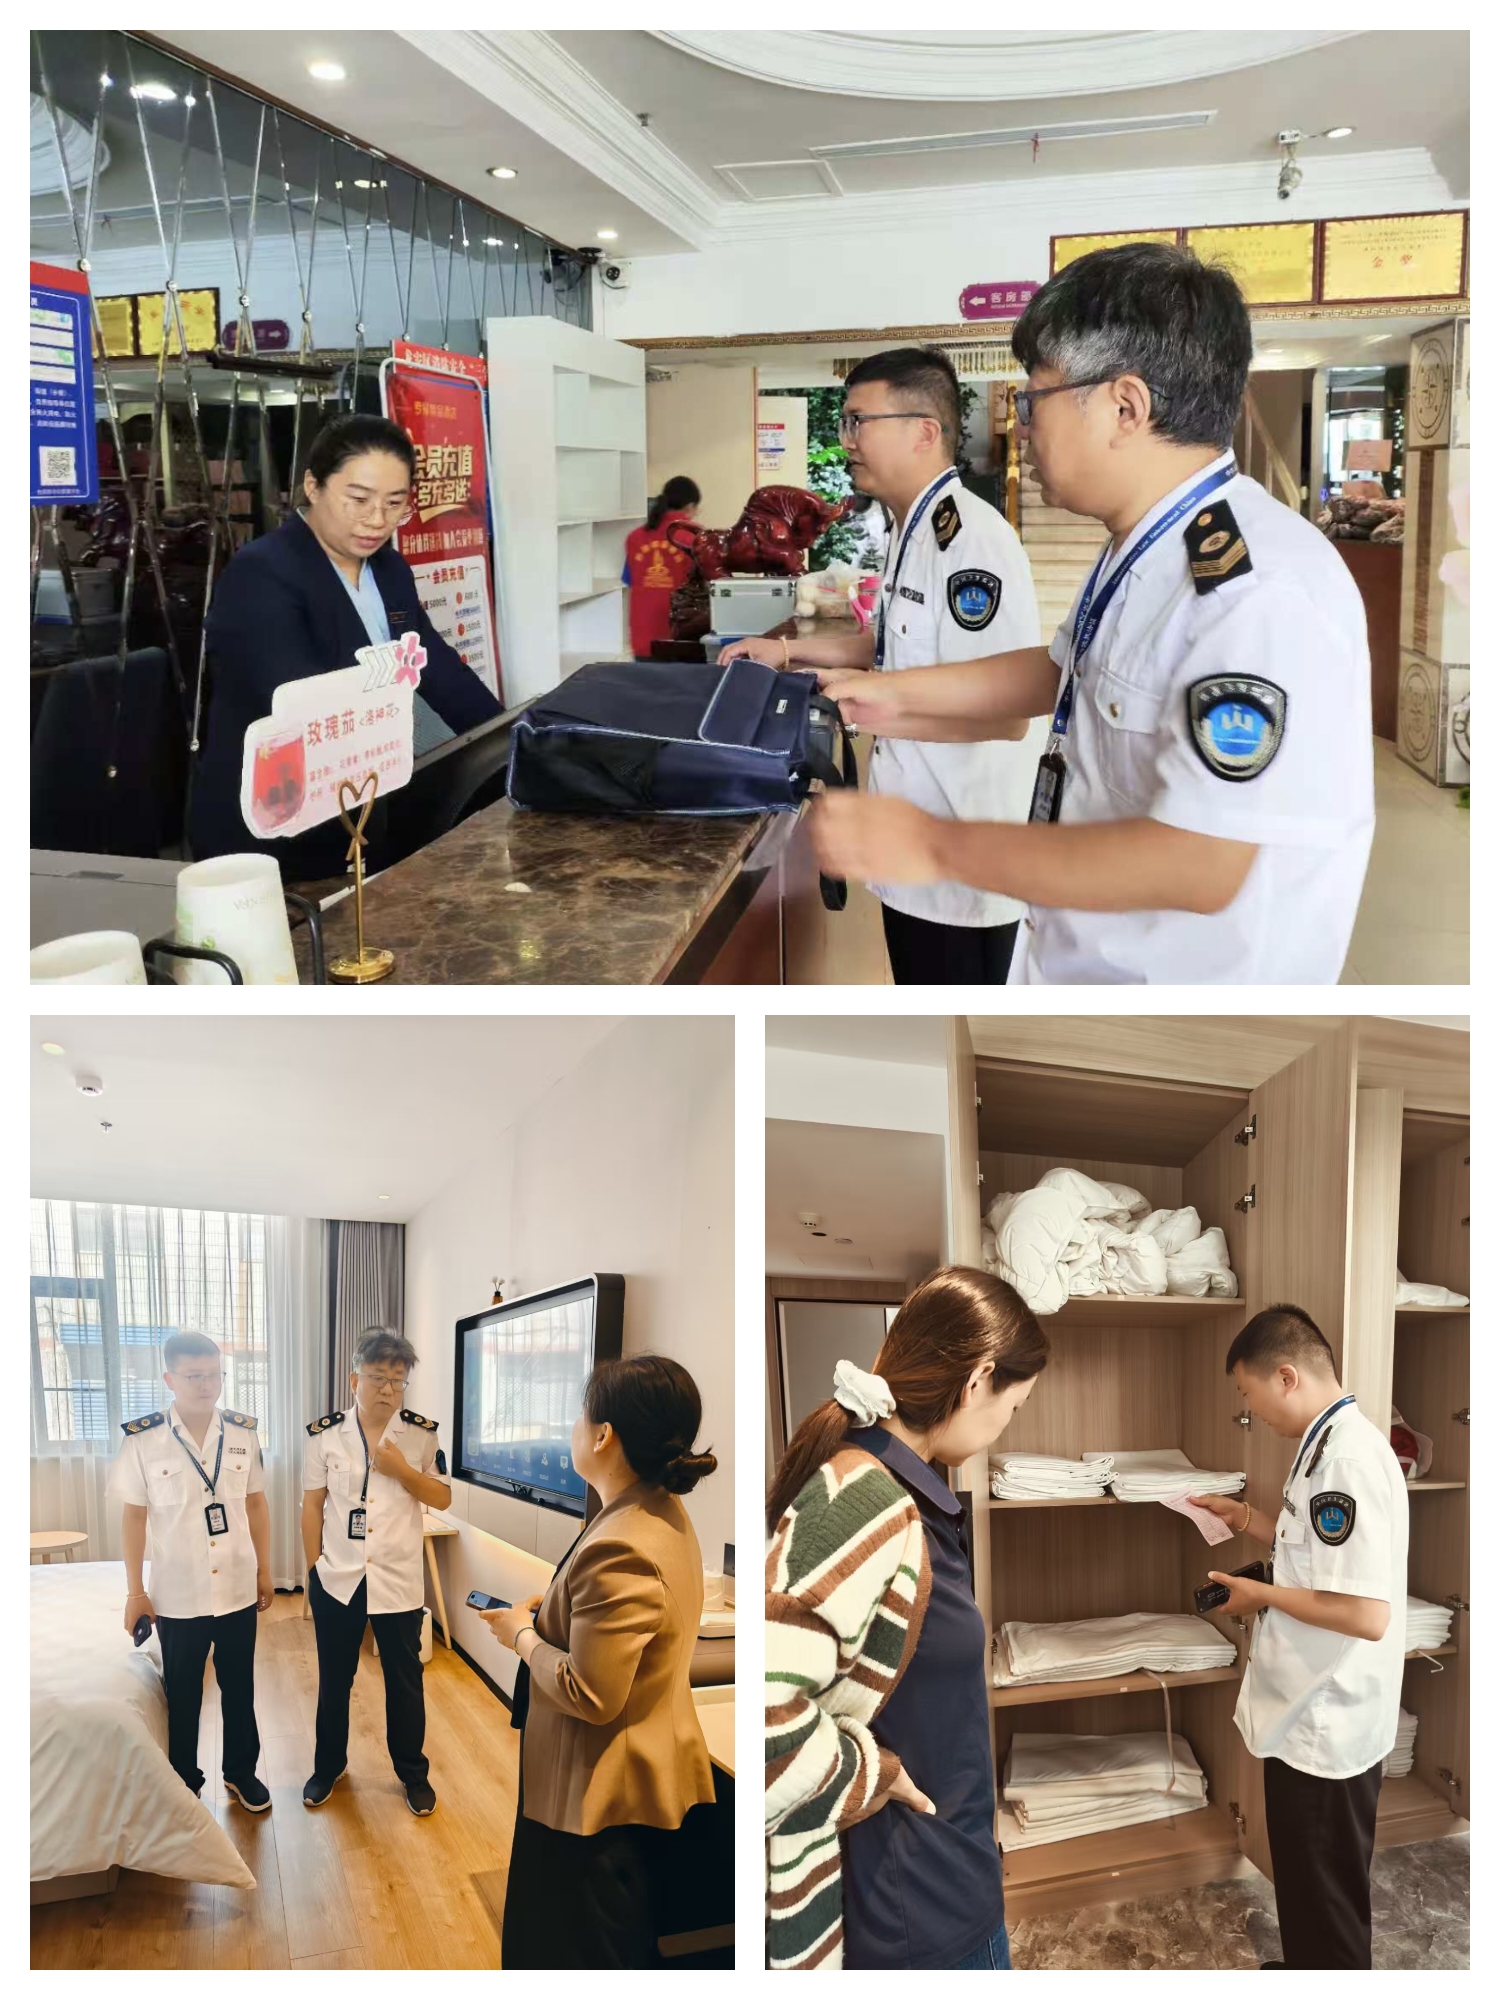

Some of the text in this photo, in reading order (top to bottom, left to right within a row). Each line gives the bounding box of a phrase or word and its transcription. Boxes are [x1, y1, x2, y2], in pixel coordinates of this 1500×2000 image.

[990, 289, 1032, 304] 客房部
[413, 444, 473, 479] 会员充值
[418, 477, 468, 506] 多充多送
[432, 565, 465, 584] 会员充值
[307, 709, 355, 747] 玫瑰茄
